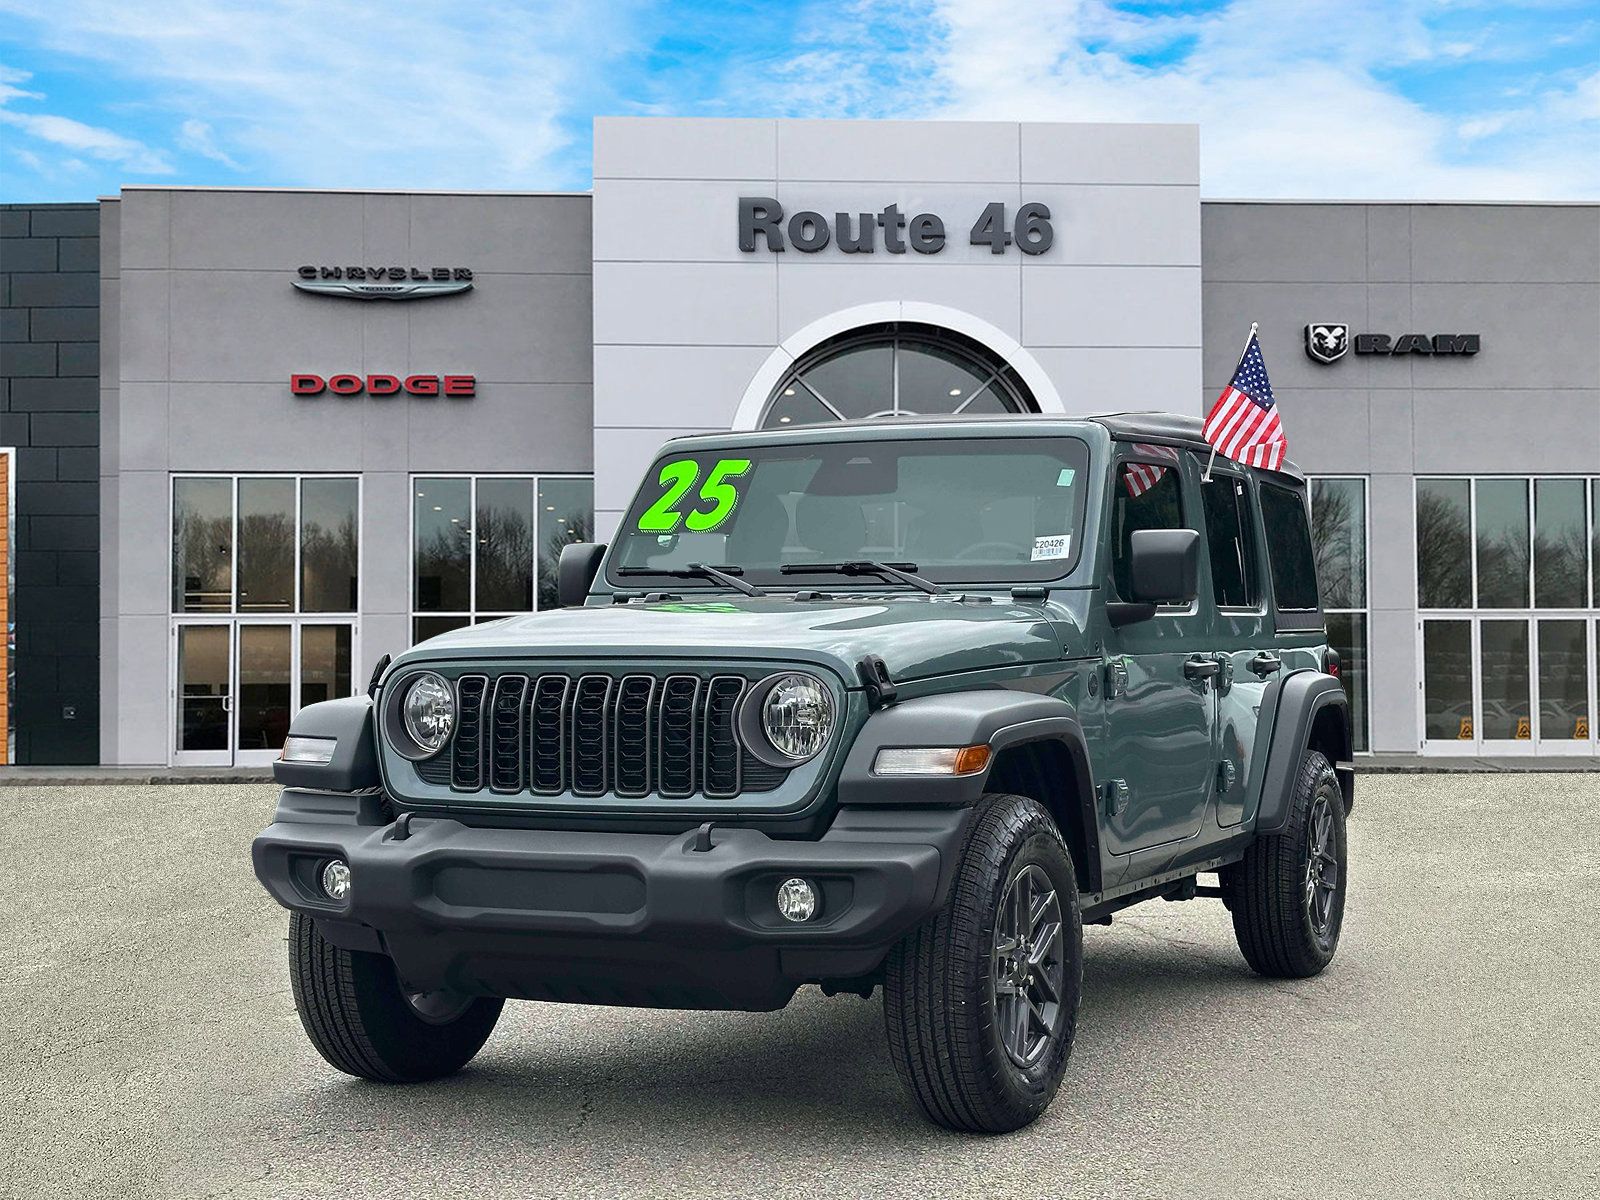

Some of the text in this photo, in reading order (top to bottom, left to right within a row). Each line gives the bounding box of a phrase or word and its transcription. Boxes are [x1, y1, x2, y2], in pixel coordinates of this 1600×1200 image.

[738, 196, 1054, 256] Route 46
[298, 265, 474, 281] CHRYSLER
[1354, 334, 1480, 356] RAM
[291, 374, 476, 397] DODGE
[638, 459, 752, 534] 25
